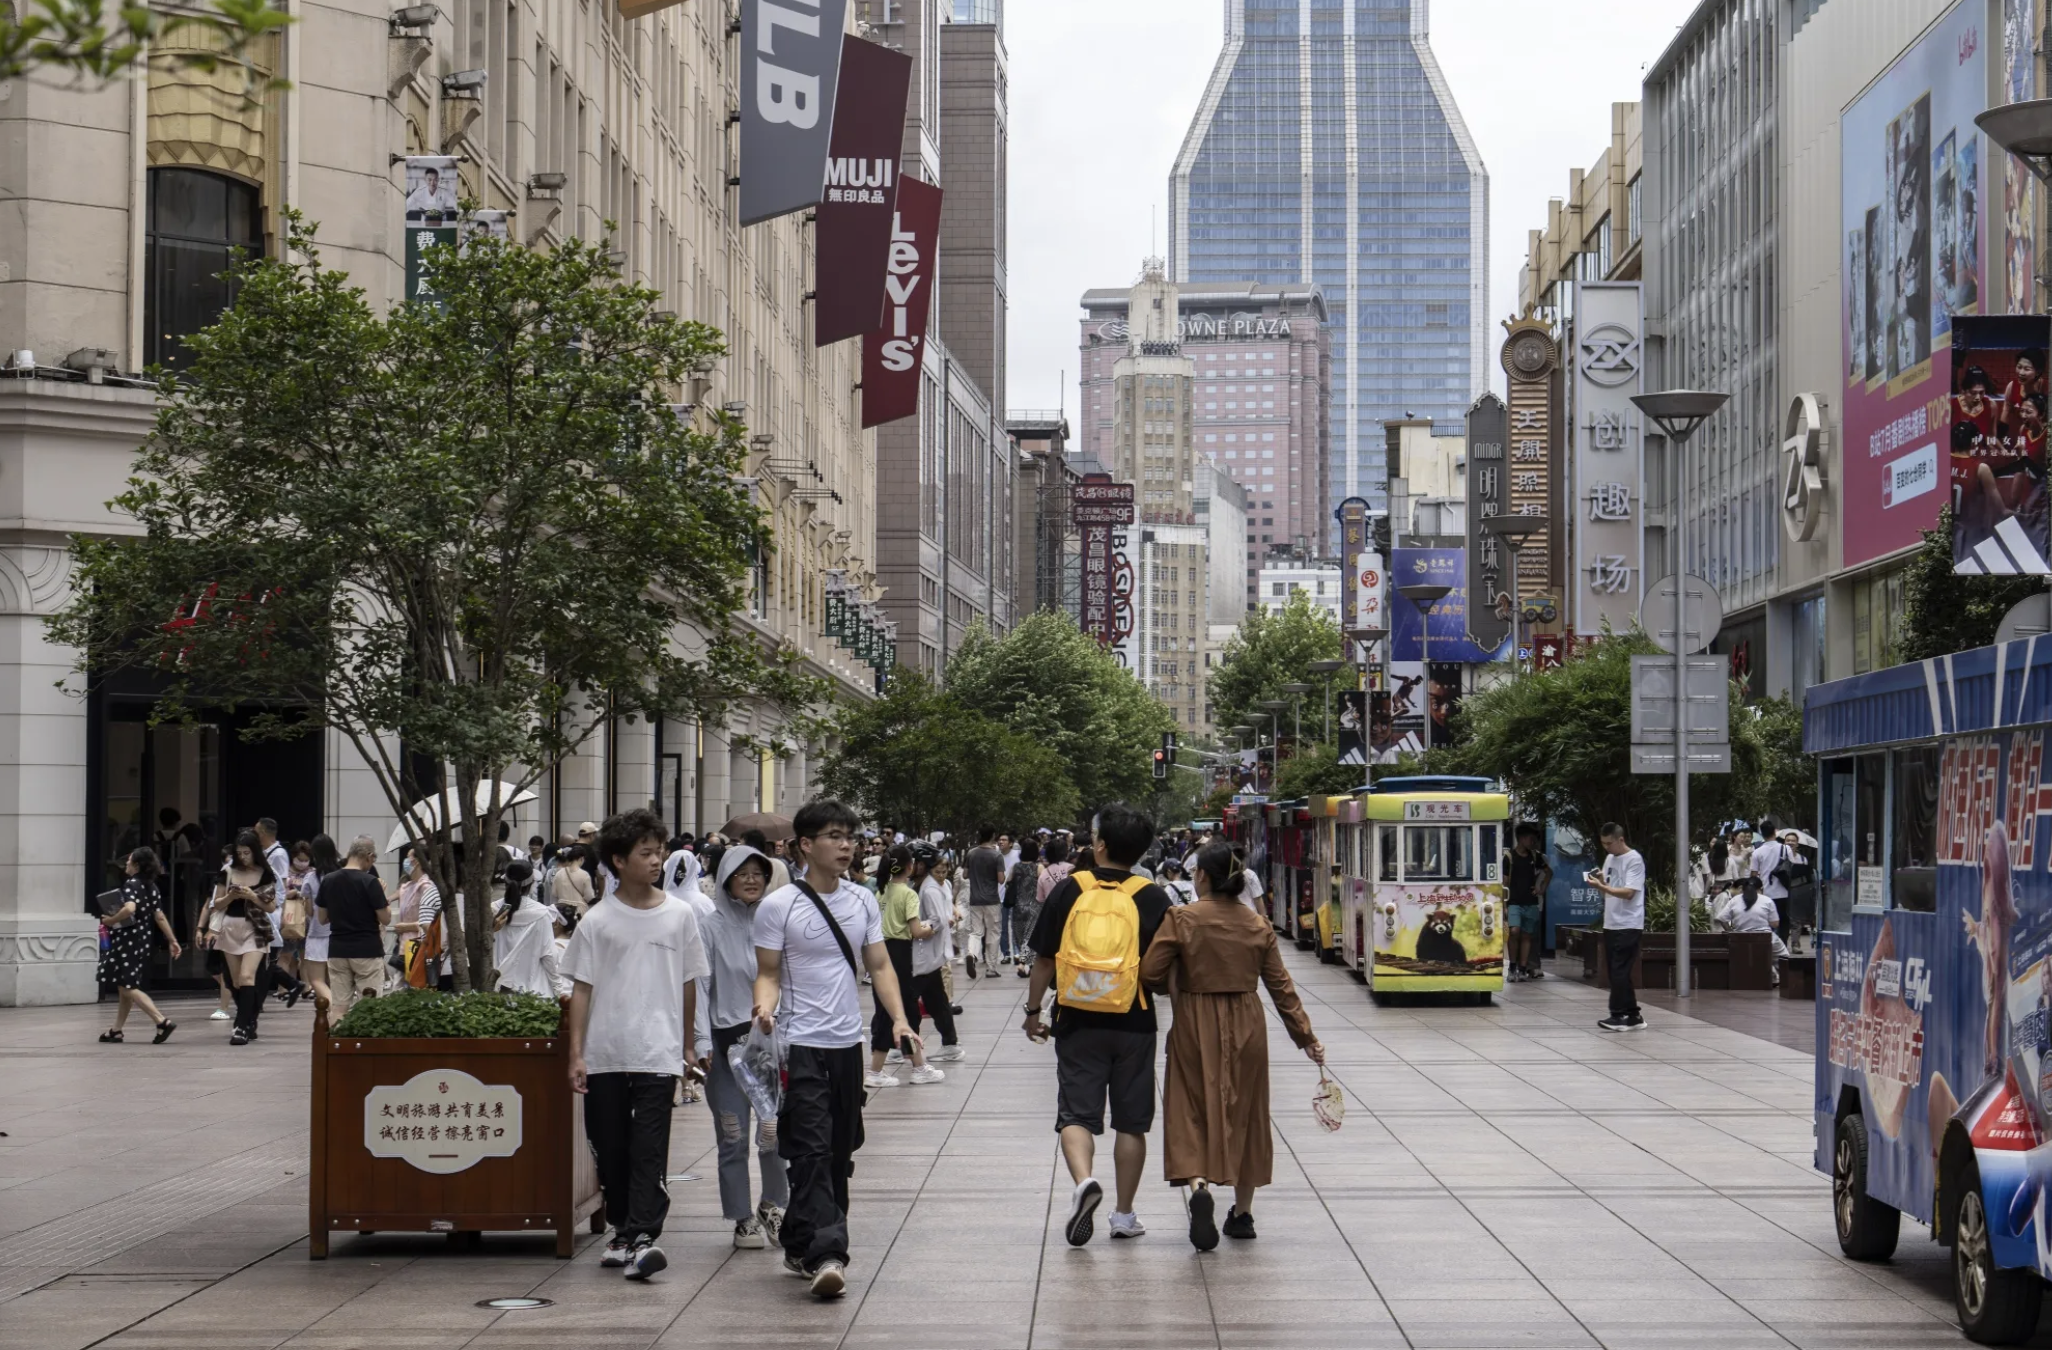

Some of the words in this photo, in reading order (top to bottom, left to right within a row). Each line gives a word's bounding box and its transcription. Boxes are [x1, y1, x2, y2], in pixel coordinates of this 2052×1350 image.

[824, 157, 892, 187] MUJI
[828, 188, 885, 204] 無印良品
[1234, 320, 1291, 334] PLAZA
[1972, 434, 2026, 446] 中国女排
[1590, 408, 1632, 593] 创趣场
[1117, 507, 1132, 521] 9F
[1087, 526, 1107, 638] 茂昌眼镜验配中
[1426, 804, 1463, 813] 观光车
[1488, 864, 1496, 879] 8
[1570, 888, 1600, 902] 智界
[380, 1103, 441, 1118] 文明旅游
[444, 1101, 505, 1118] 共育美景
[379, 1125, 441, 1141] 诚信经营
[445, 1125, 505, 1141] 擦亮窗口
